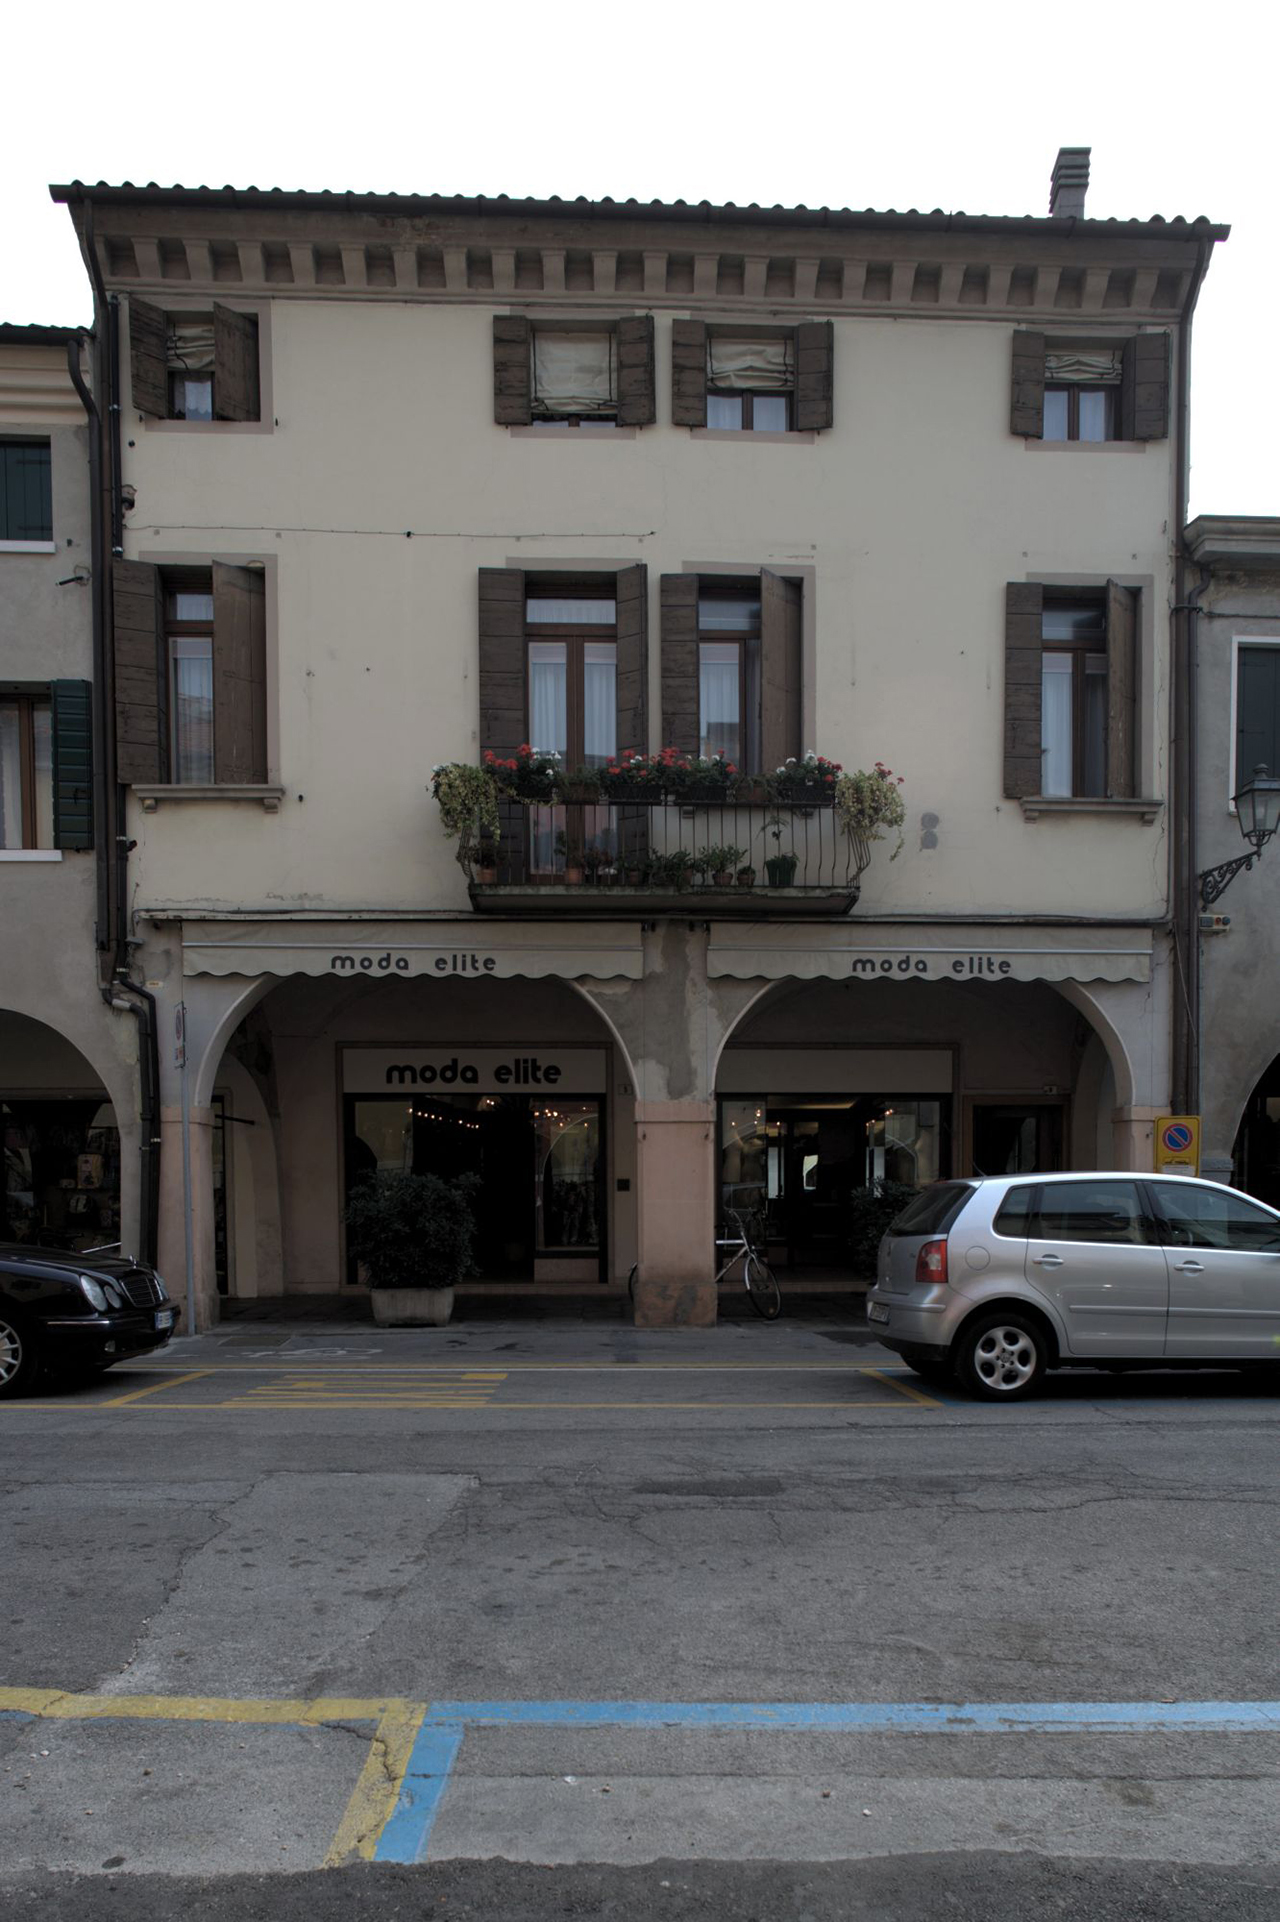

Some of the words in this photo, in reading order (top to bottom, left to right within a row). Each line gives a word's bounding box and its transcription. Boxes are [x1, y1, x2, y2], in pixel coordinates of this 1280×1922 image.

[331, 953, 409, 971] moda
[434, 954, 496, 972] elite
[852, 955, 928, 973] moda
[952, 956, 1012, 975] elite
[386, 1058, 479, 1085] moda
[493, 1058, 562, 1085] elite
